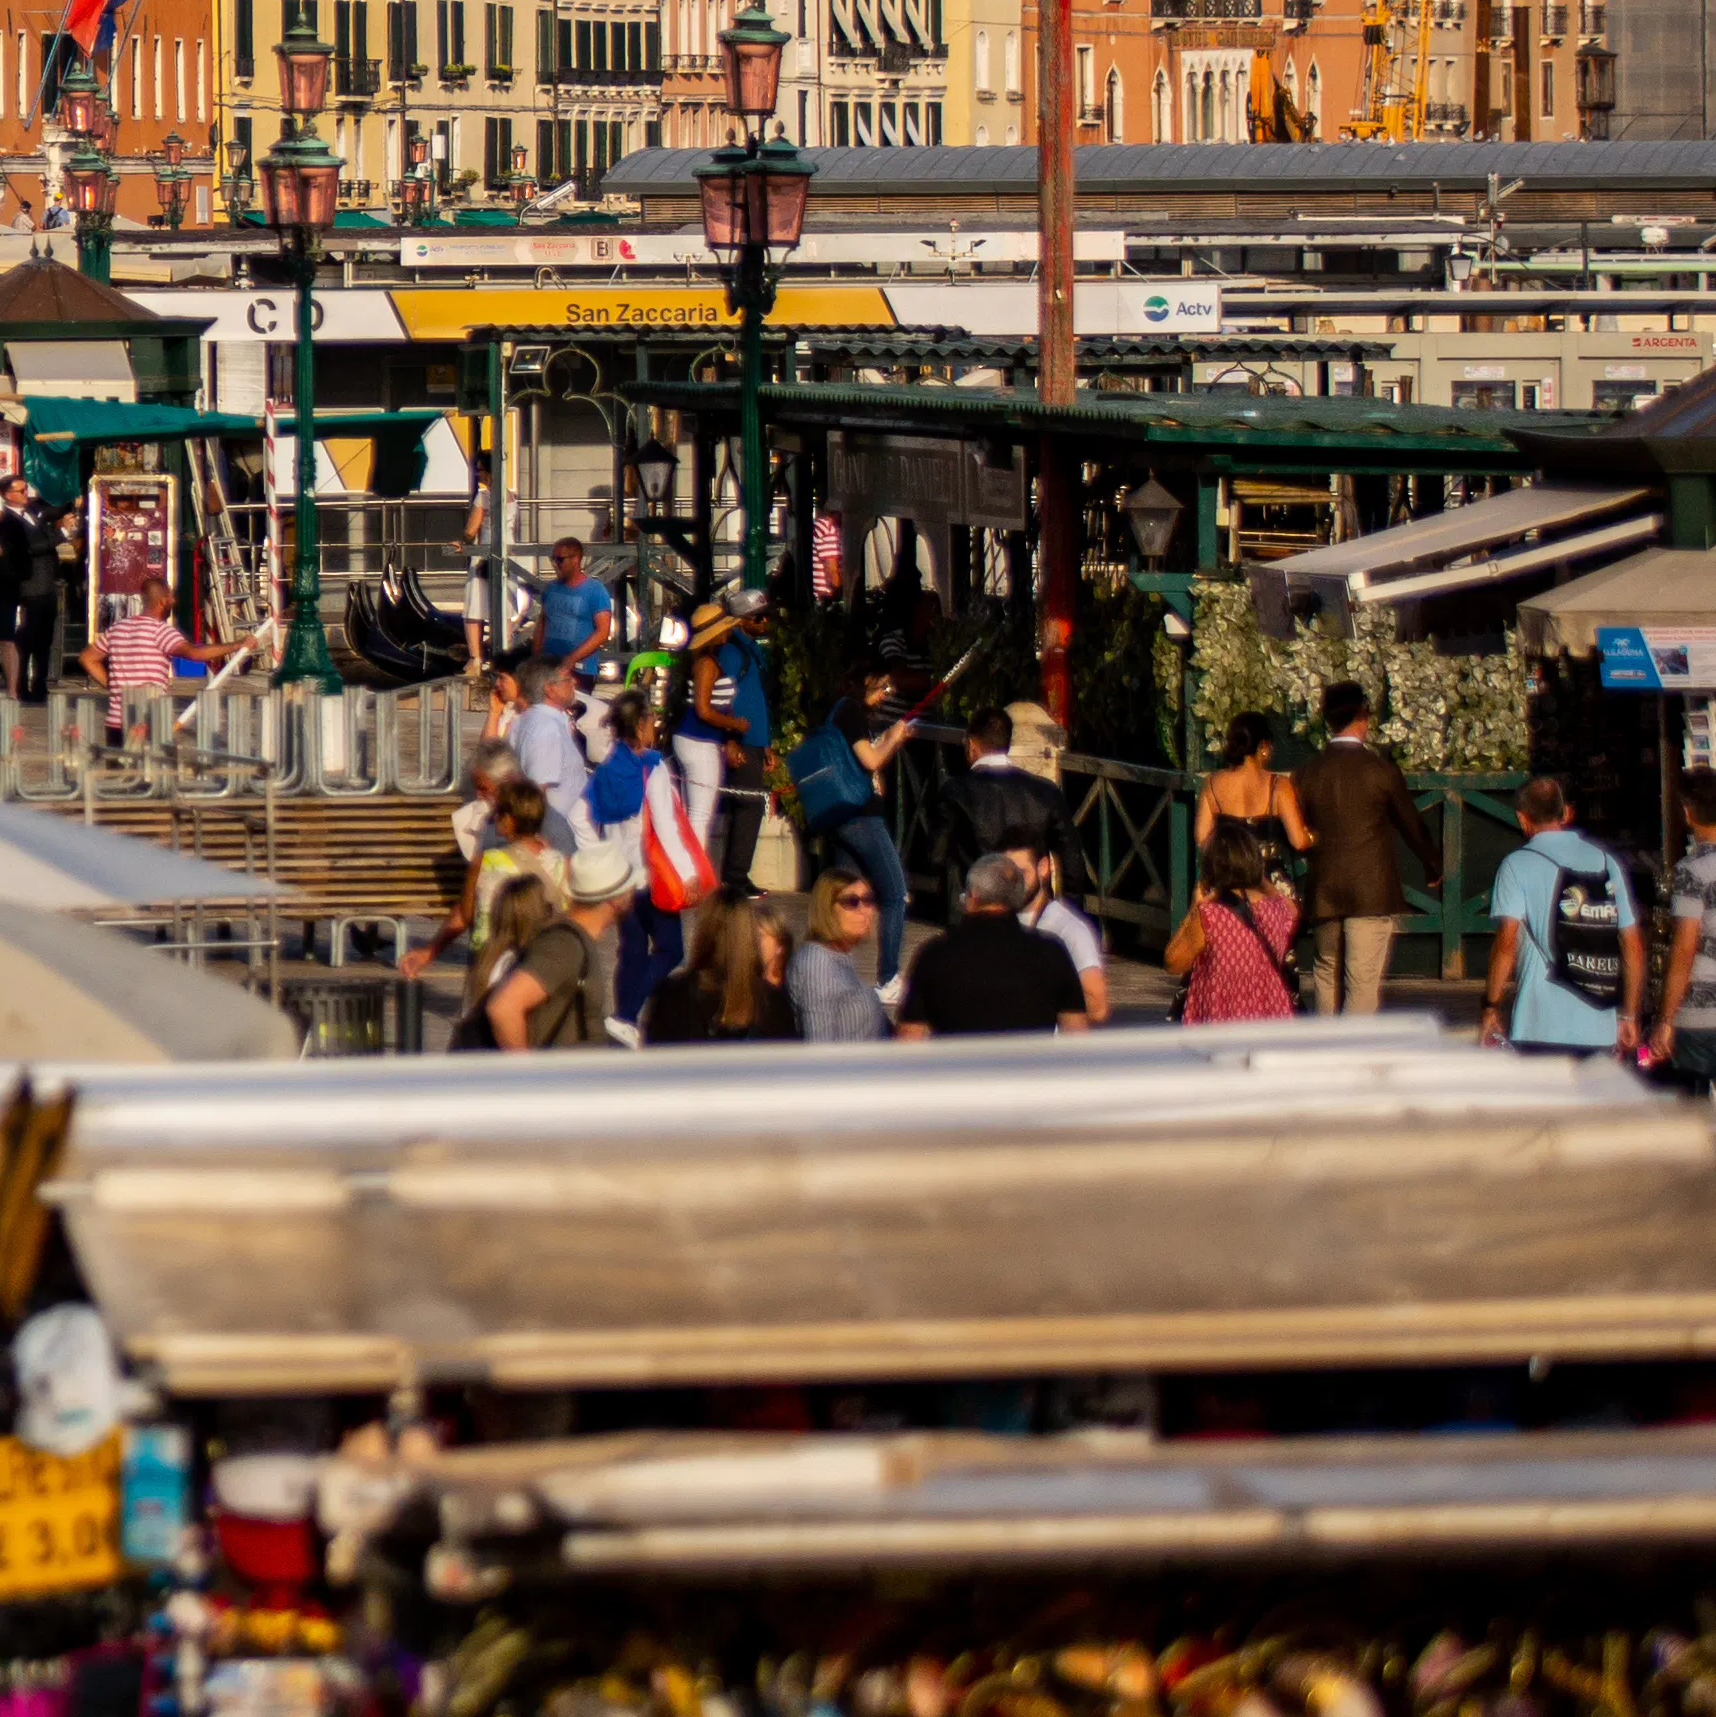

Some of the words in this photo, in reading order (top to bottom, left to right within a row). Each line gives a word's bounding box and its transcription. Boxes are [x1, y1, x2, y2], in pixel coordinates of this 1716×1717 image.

[247, 298, 277, 335] C
[567, 303, 609, 323] San
[617, 302, 718, 324] Zaccaria
[1176, 302, 1212, 316] Actv
[1643, 337, 1697, 347] ARGENTA
